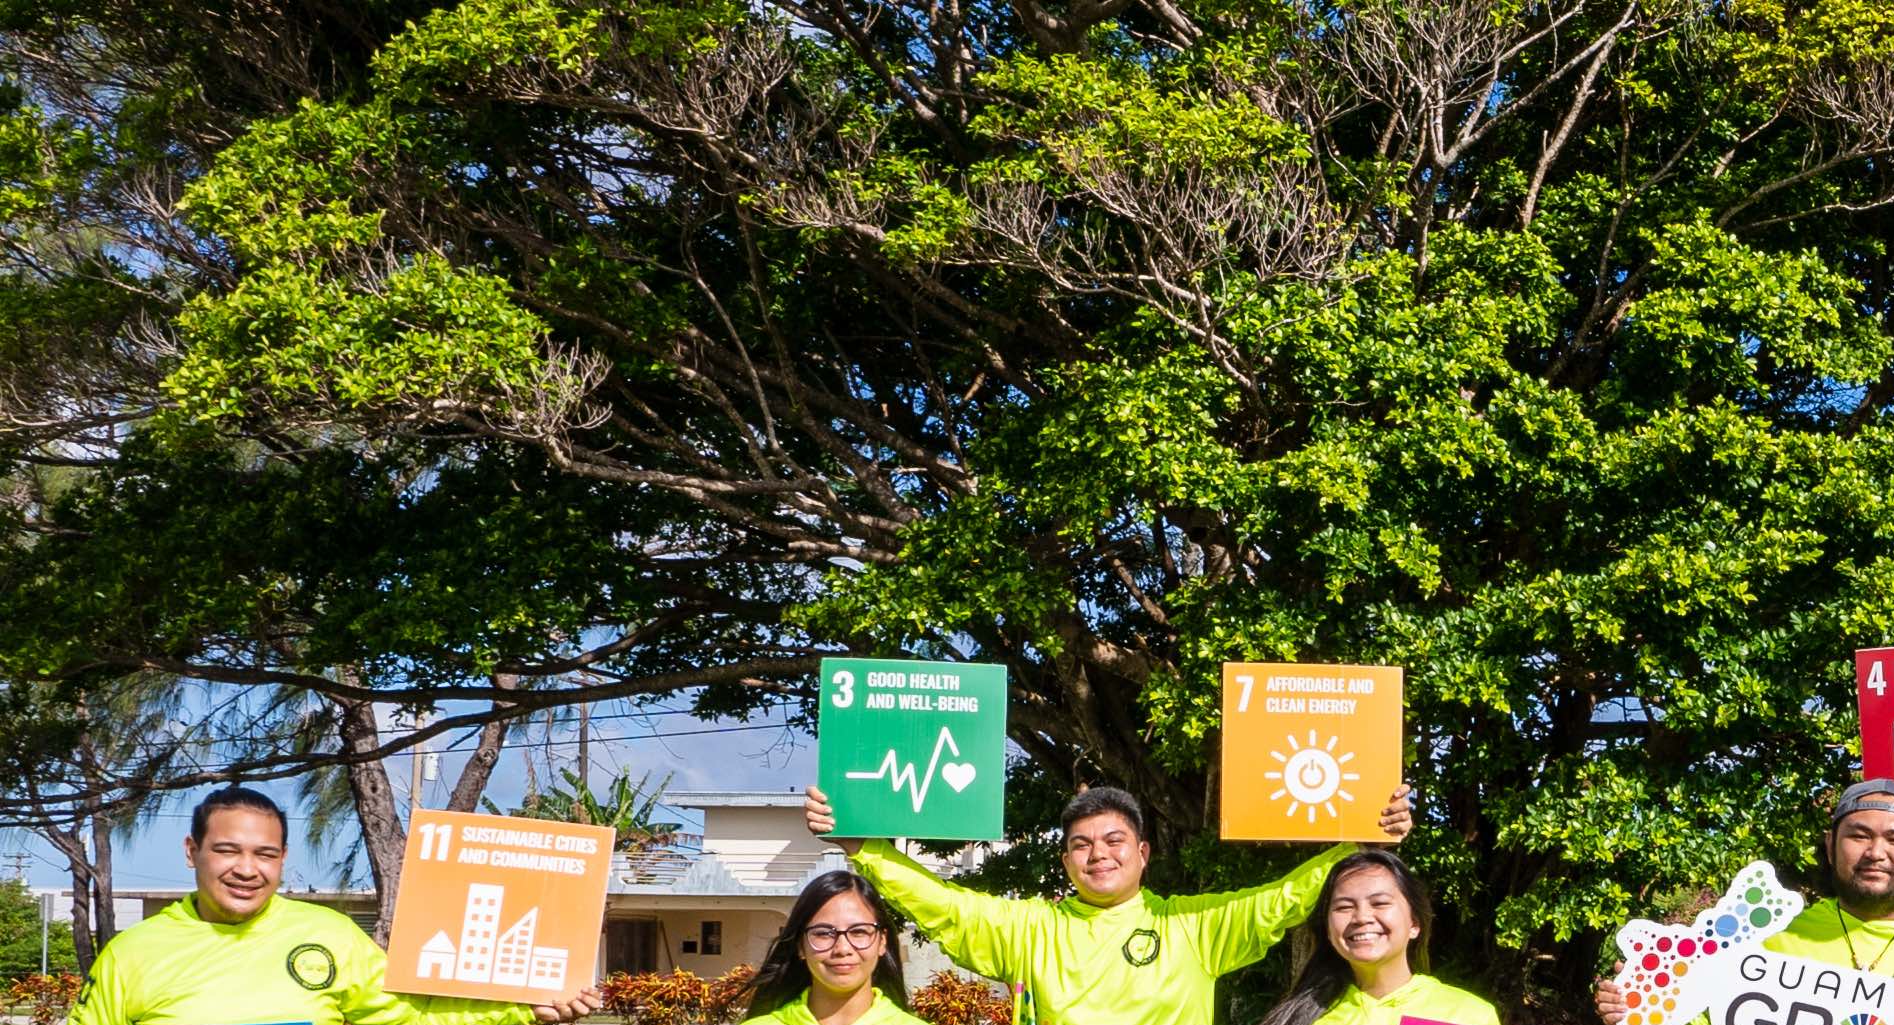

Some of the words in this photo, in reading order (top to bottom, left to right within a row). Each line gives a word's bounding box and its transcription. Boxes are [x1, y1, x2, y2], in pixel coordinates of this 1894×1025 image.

[832, 671, 854, 708] 3
[867, 672, 906, 688] GOOD
[910, 674, 960, 690] HEALTH
[1266, 677, 1344, 693] AFFORDABLE
[1348, 679, 1374, 694] AND
[1867, 661, 1886, 695] 4
[866, 693, 895, 709] AND
[899, 694, 978, 712] WELL-BEING
[1236, 676, 1254, 712] 7
[1266, 698, 1306, 712] CLEAN
[1309, 699, 1356, 714] ENERGY
[419, 823, 452, 861] 11
[462, 827, 554, 849] SUSTAINABLE
[555, 835, 597, 854] CITIES
[458, 848, 489, 866] AND
[491, 850, 585, 875] COMMUNITIES
[1740, 955, 1886, 1009] GUAM
